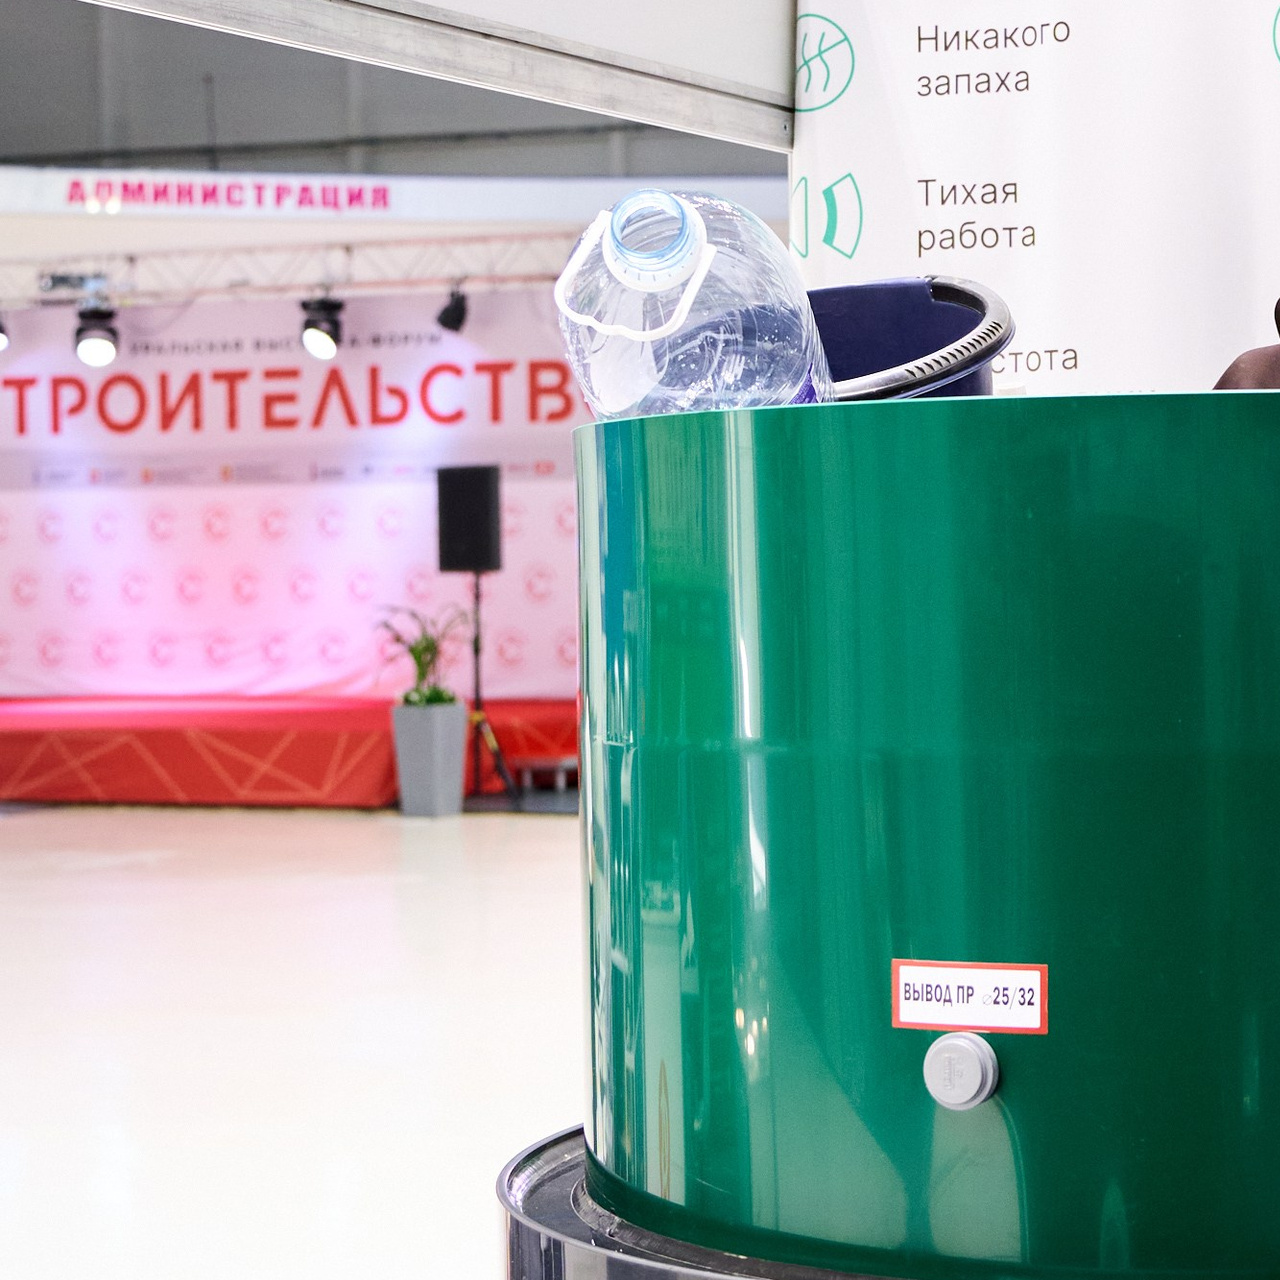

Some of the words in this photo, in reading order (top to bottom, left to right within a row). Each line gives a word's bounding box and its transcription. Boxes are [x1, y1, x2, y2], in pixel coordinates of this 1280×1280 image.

[917, 21, 1070, 53] Никакого
[917, 71, 1030, 97] запаха
[66, 178, 391, 212] АДМИНИСТРАЦИЯ
[917, 179, 1018, 206] Тихая
[918, 221, 1036, 258] работа
[2, 360, 590, 435] ТРОИТЕЛЬСТВ
[904, 982, 953, 1007] ВЫВОД
[956, 985, 974, 1004] ПР
